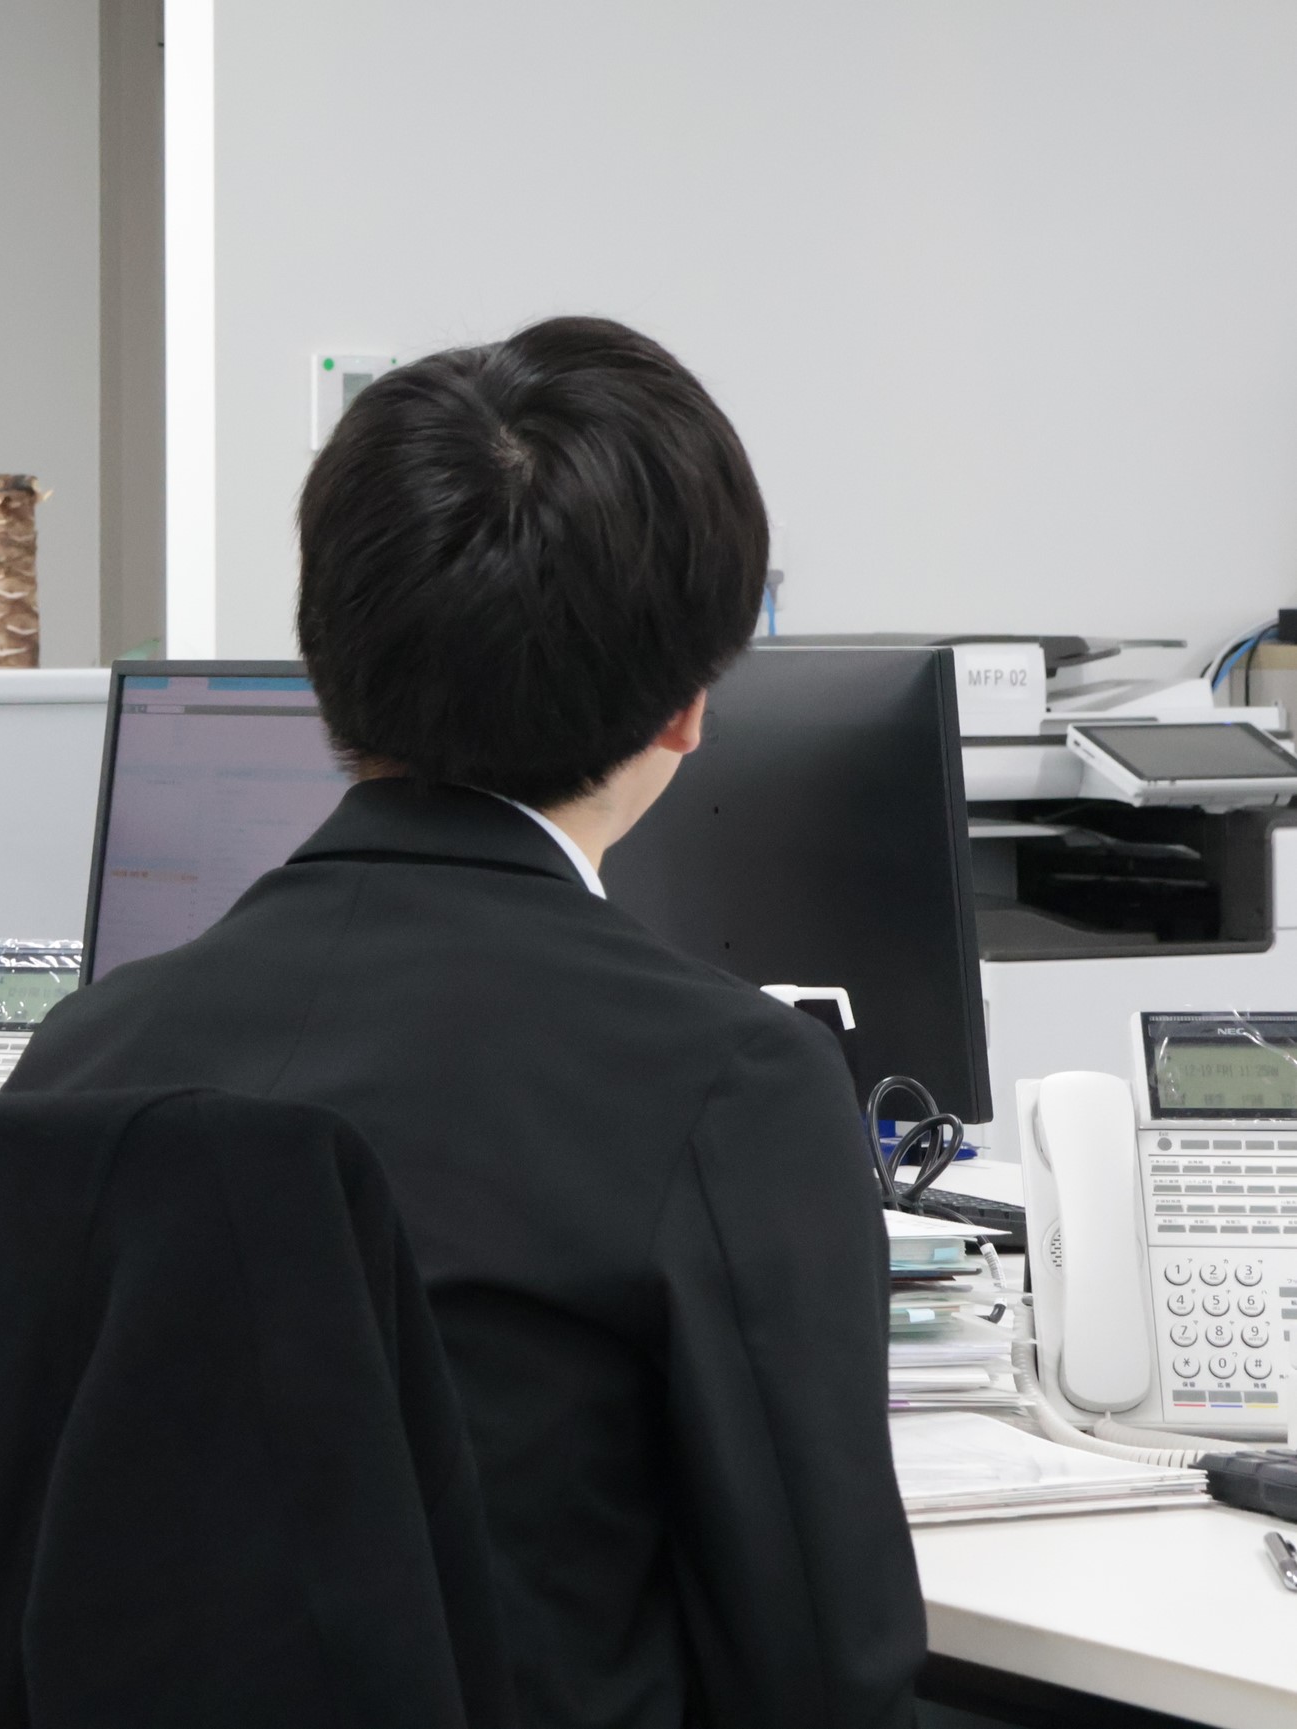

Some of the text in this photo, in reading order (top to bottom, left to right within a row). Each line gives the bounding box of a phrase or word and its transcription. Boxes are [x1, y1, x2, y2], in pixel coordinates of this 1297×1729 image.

[968, 669, 1028, 686] MFP 02
[1217, 1027, 1245, 1035] NEC
[1175, 1264, 1180, 1275] 1
[1209, 1265, 1217, 1275] 2
[1245, 1265, 1253, 1275] 3
[1176, 1294, 1184, 1305] 4
[1212, 1295, 1220, 1305] 5
[1247, 1295, 1255, 1306] 6
[1180, 1325, 1188, 1336] 7
[1215, 1325, 1223, 1336] 8
[1251, 1326, 1259, 1337] 9
[1218, 1358, 1227, 1369] 0
